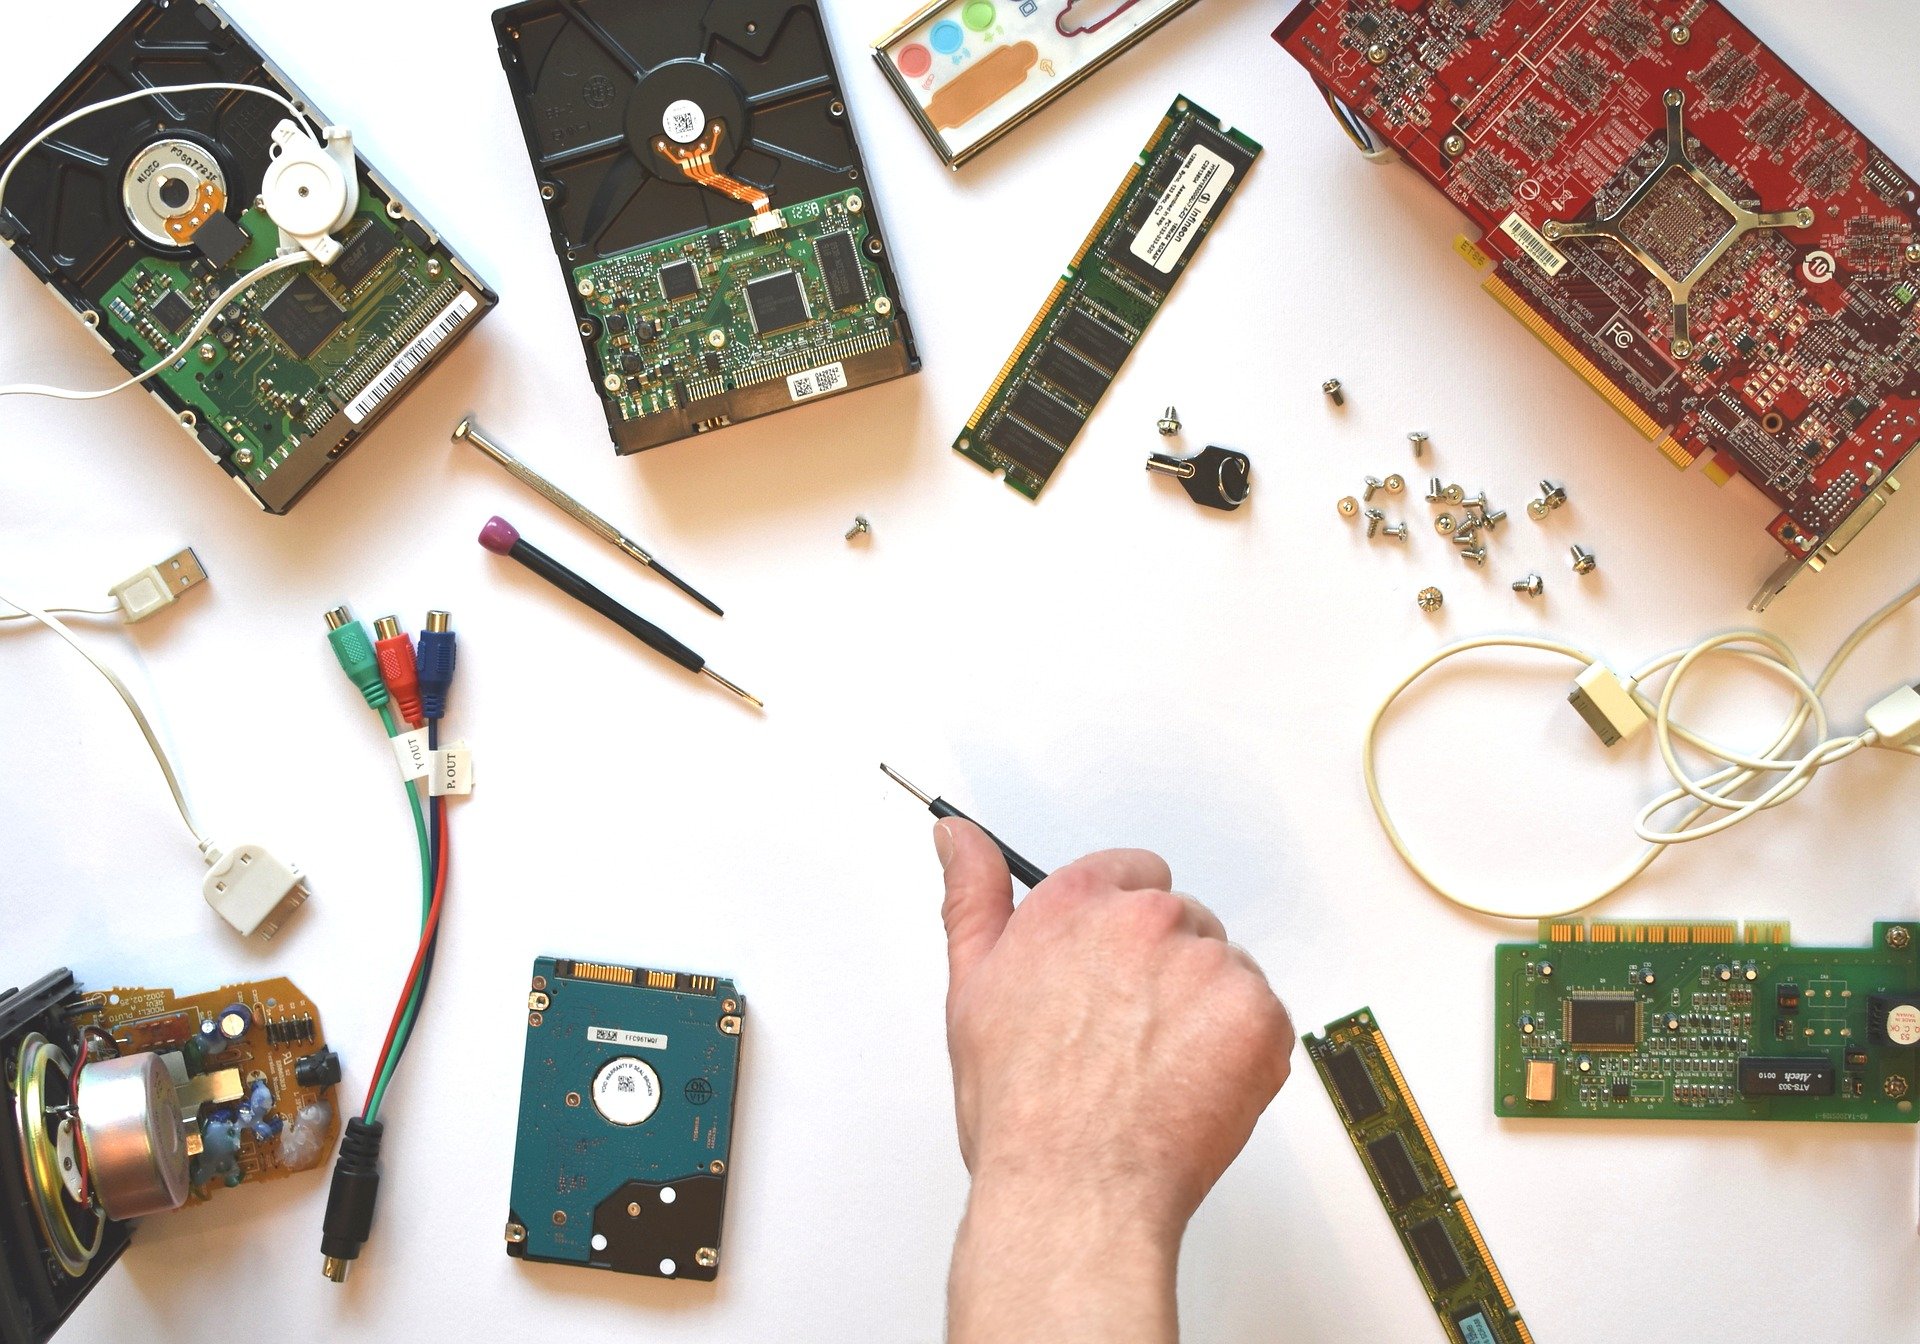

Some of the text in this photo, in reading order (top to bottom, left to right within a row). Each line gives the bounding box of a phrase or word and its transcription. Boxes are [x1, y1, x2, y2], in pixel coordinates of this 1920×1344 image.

[137, 161, 159, 184] NIDEC
[1174, 207, 1202, 244] Infineon
[1811, 259, 1827, 275] 10
[408, 739, 424, 770] Y OUT
[447, 753, 456, 789] P. OUT
[109, 1011, 133, 1022] PLUTO
[1890, 1024, 1900, 1032] OK
[1785, 1072, 1811, 1082] Atech
[691, 1082, 705, 1091] OK
[1778, 1083, 1810, 1091] ATS-303
